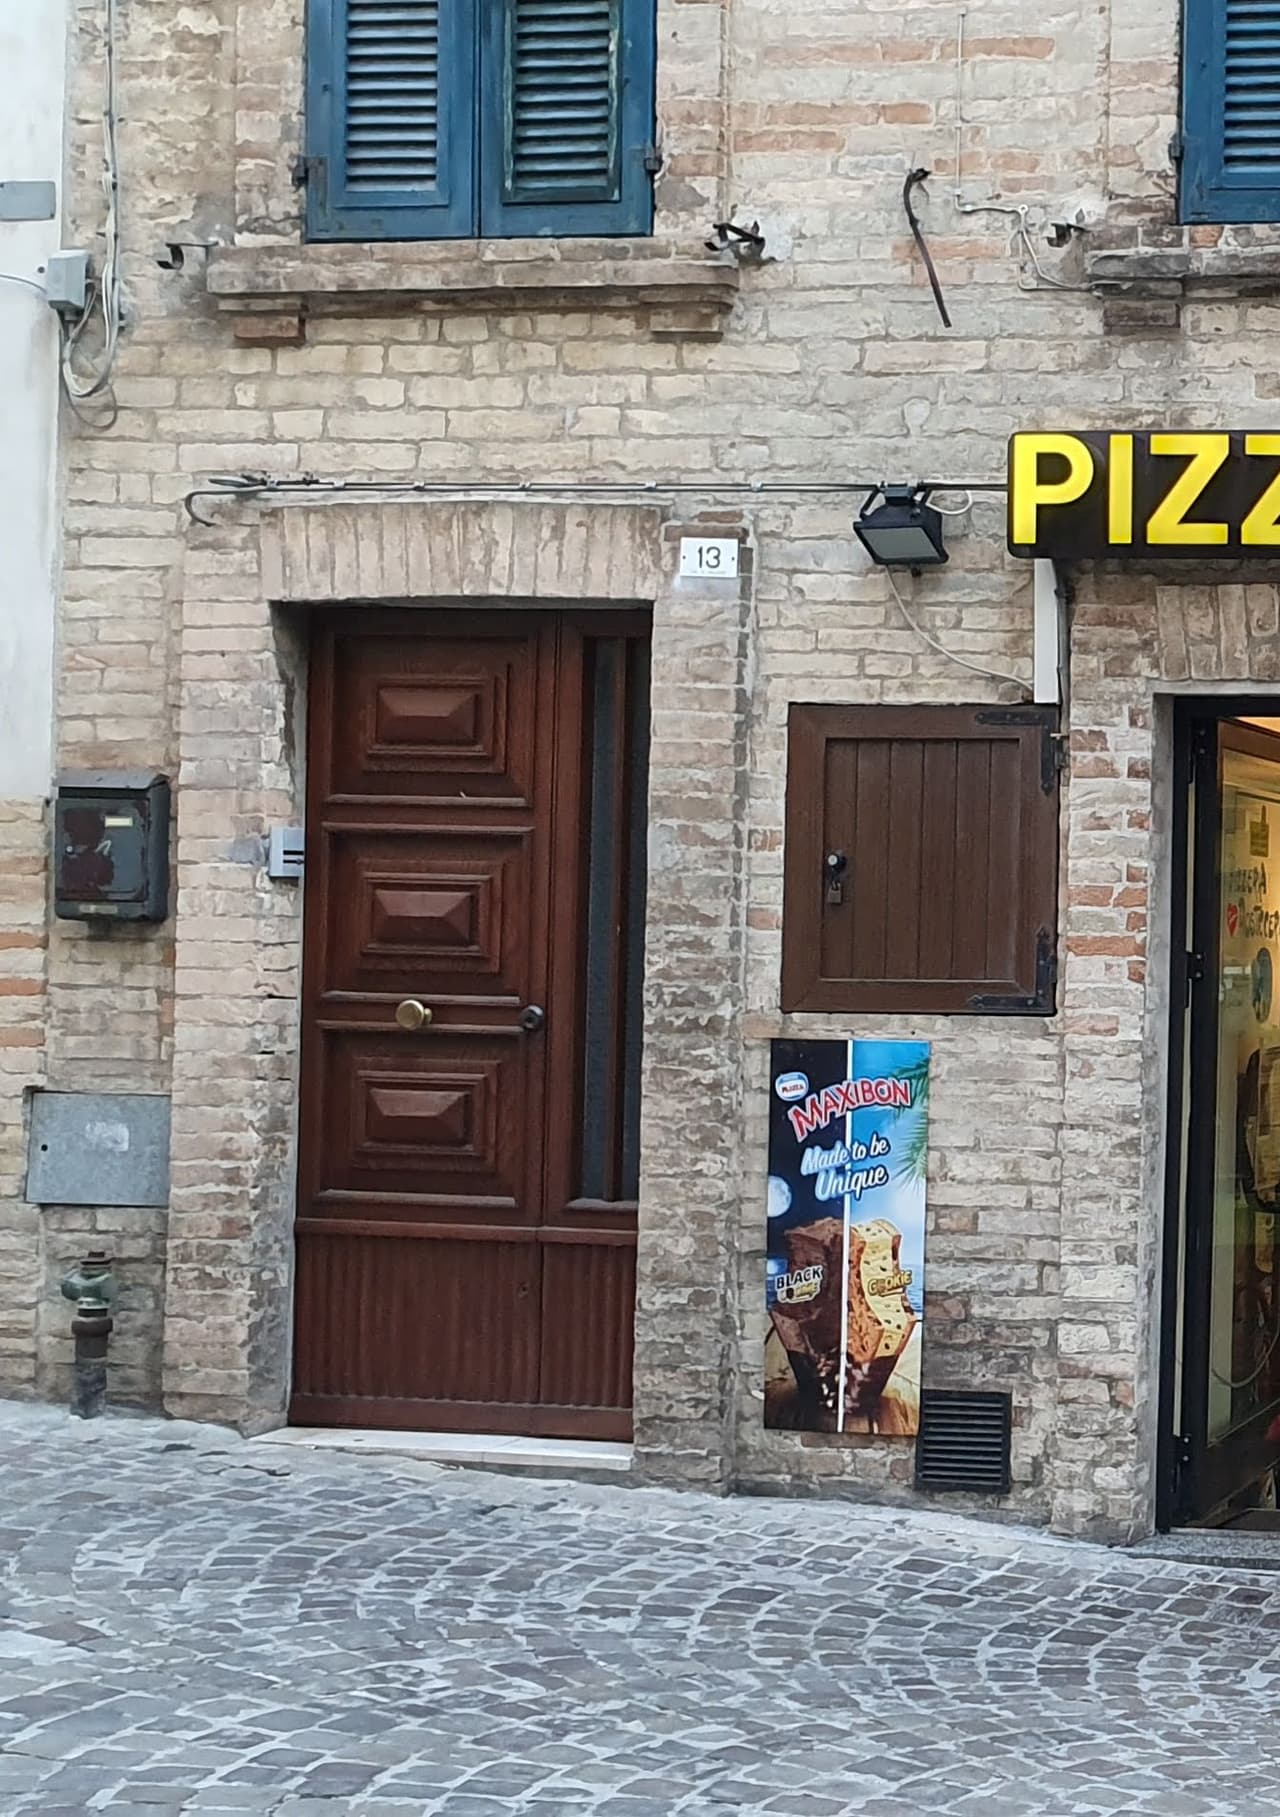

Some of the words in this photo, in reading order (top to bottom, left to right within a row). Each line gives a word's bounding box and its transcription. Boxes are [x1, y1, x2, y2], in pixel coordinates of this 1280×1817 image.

[697, 546, 721, 569] 13
[788, 1078, 911, 1142] MAXIBON
[801, 1140, 849, 1176] Made
[852, 1141, 867, 1160] to
[870, 1133, 889, 1156] be
[815, 1165, 888, 1200] Unique
[776, 1266, 821, 1290] BLACK
